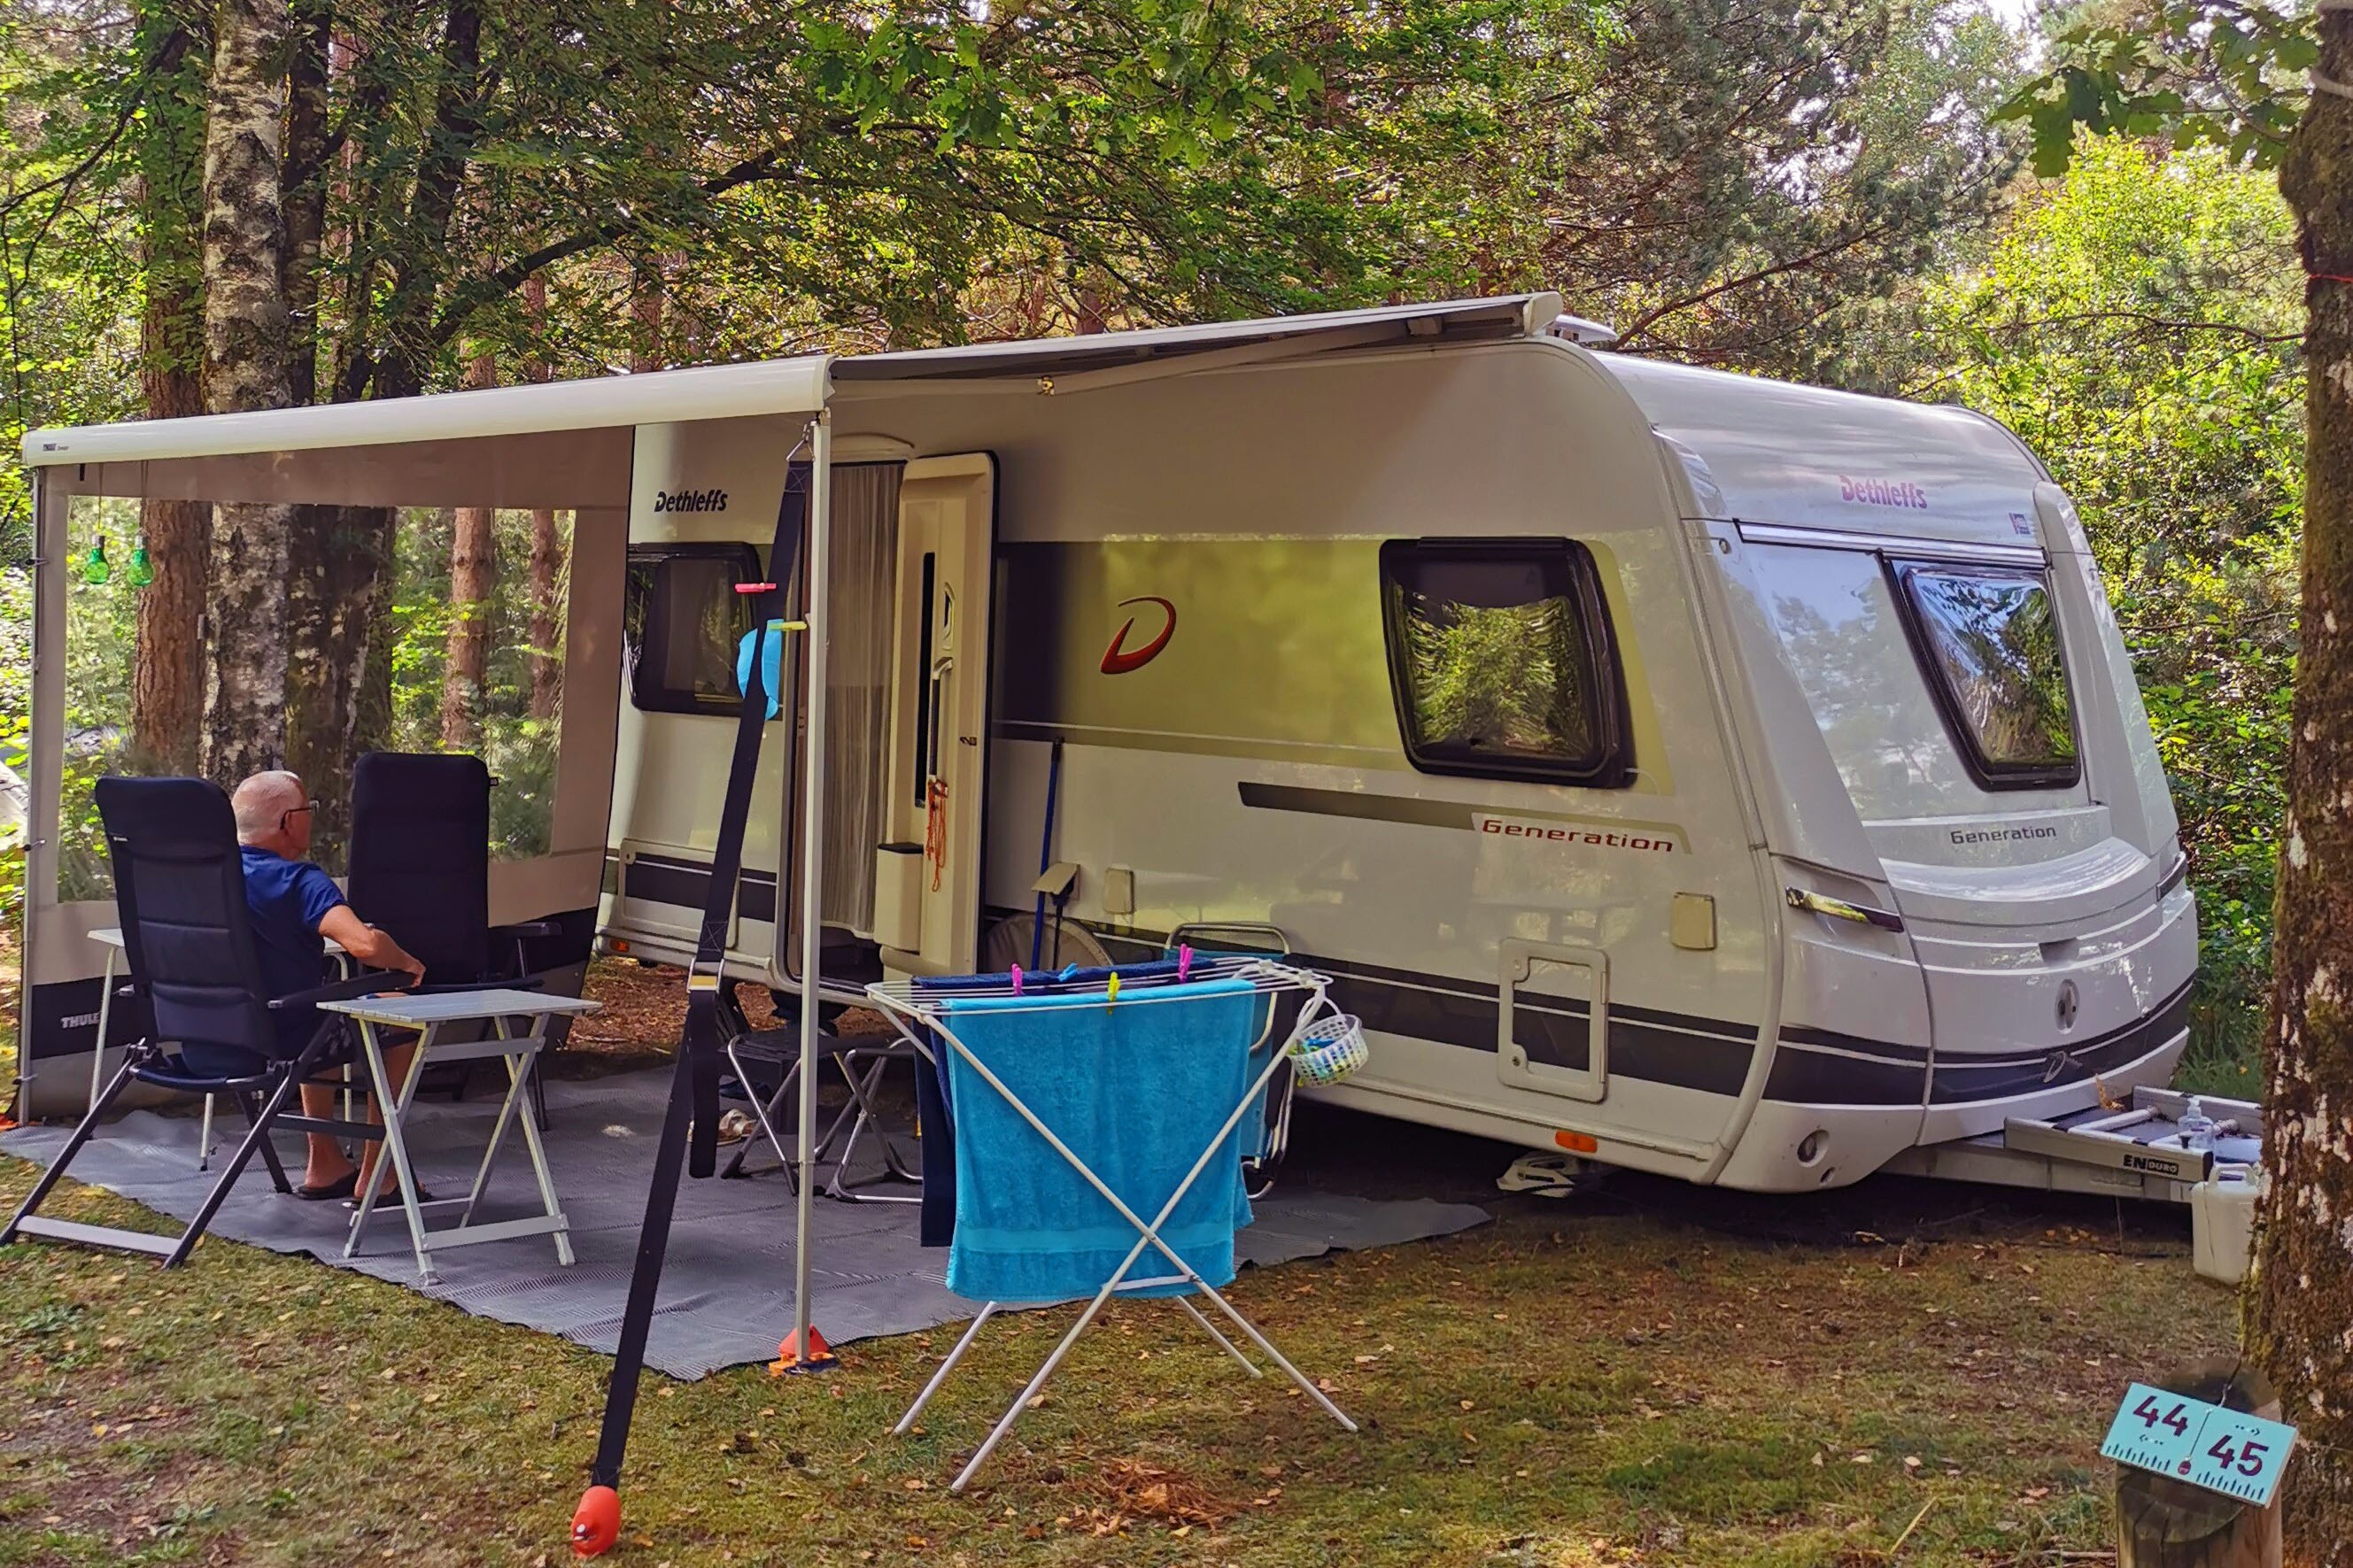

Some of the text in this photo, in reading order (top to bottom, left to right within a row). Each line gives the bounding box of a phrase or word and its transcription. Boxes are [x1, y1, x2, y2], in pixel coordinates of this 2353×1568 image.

[654, 489, 728, 513] Dethleffs
[1839, 474, 1927, 509] Dethleffs
[1482, 819, 1674, 853] Generation
[1950, 826, 2057, 845] Generation
[2123, 1154, 2179, 1176] ENDURO
[2132, 1394, 2189, 1437] 44
[2207, 1434, 2270, 1477] 45
